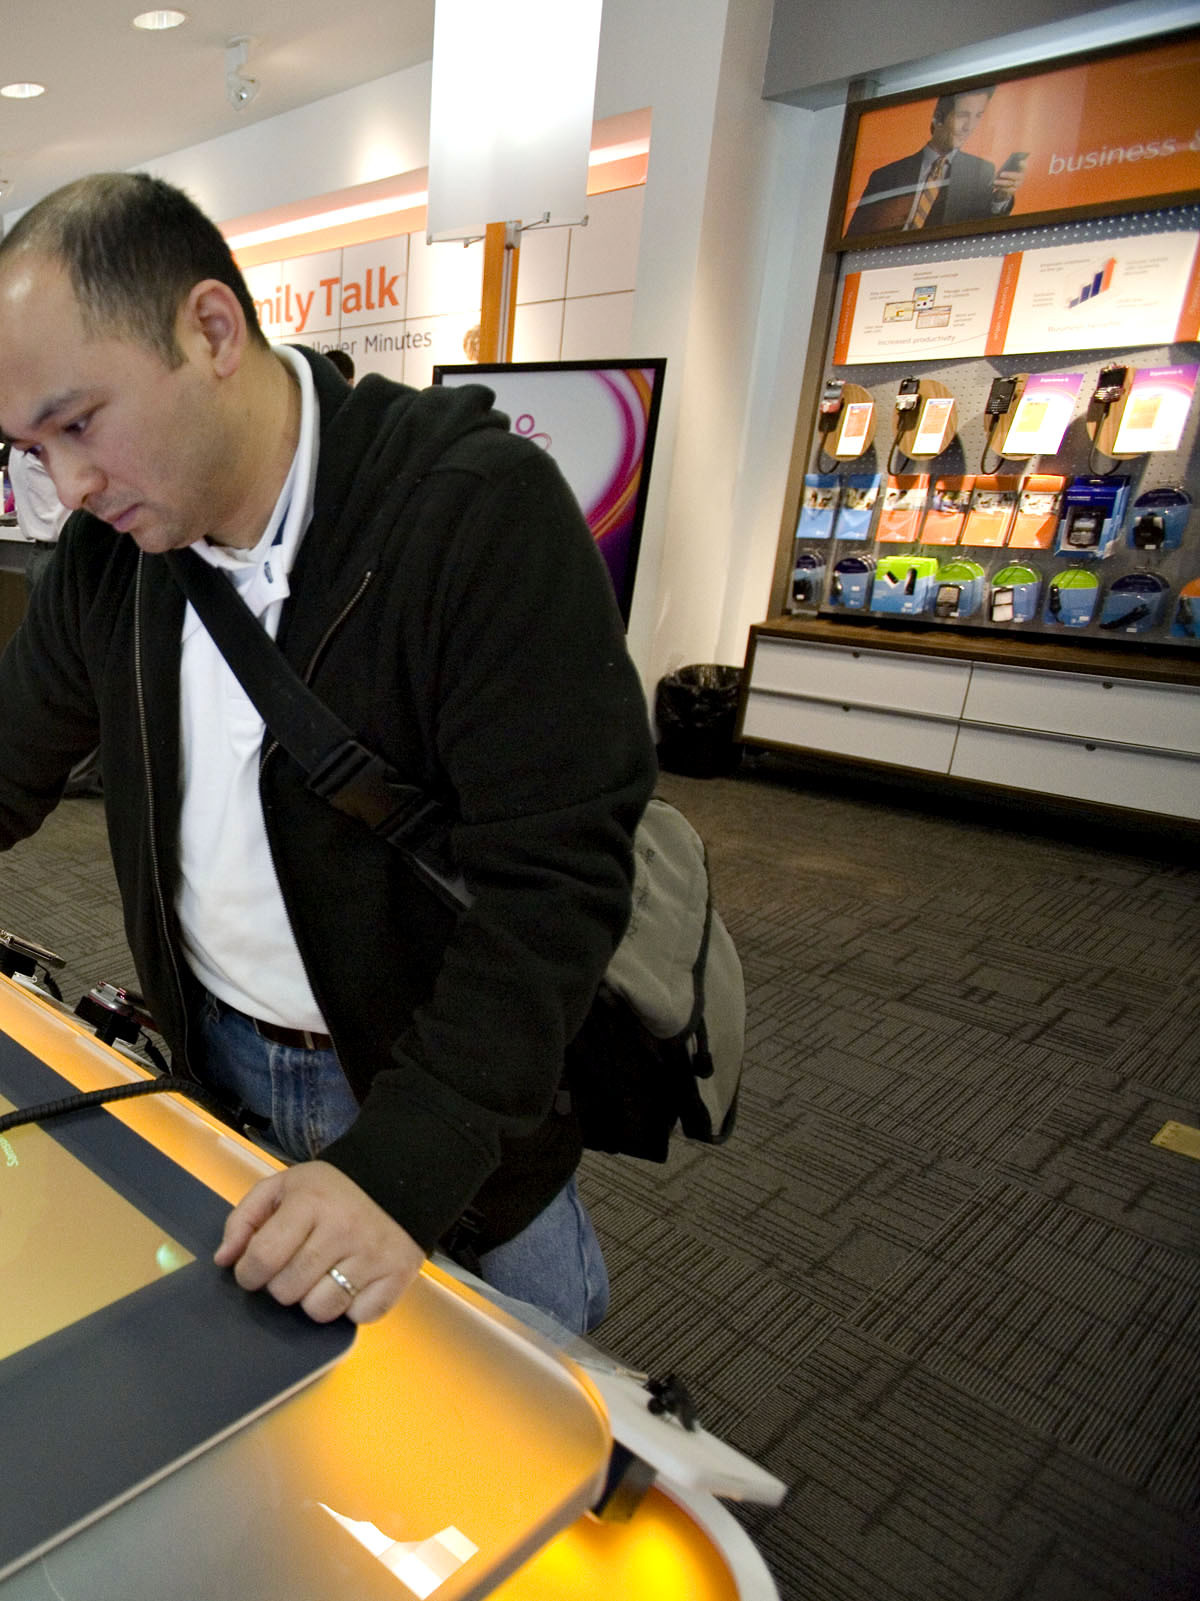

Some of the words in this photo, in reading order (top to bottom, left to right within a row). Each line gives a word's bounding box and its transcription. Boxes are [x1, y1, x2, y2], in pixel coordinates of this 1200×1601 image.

[1047, 137, 1177, 175] business
[253, 266, 401, 332] milyTalk
[364, 331, 433, 353] Minutes
